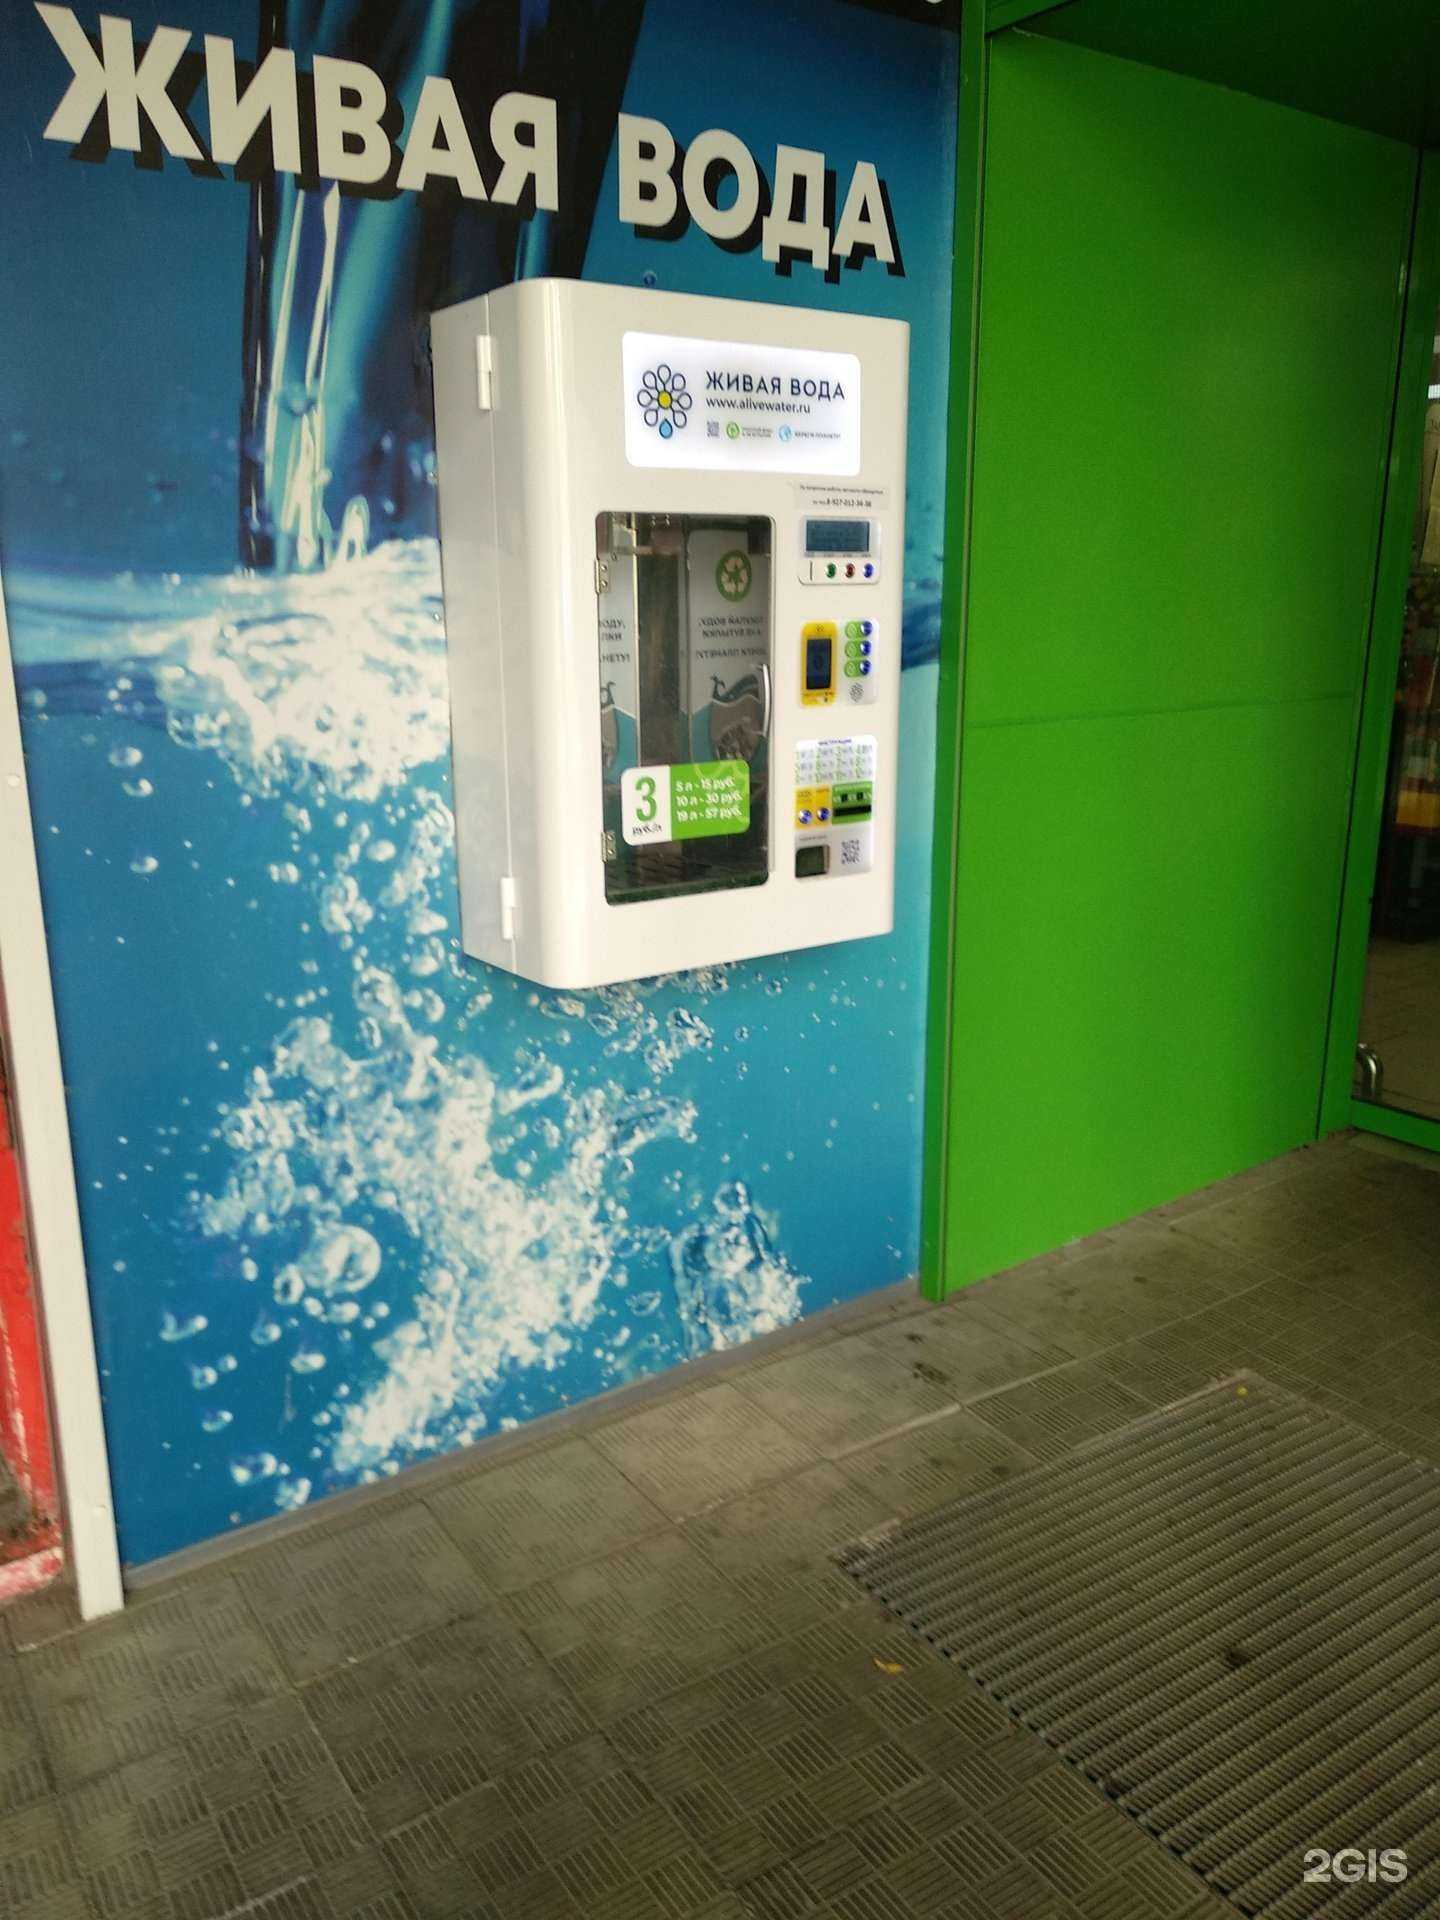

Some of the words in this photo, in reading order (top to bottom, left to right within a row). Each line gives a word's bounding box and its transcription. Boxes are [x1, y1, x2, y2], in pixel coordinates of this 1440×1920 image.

[35, 2, 559, 212] ЖИВАЯ
[618, 112, 895, 269] ВОДА
[705, 371, 781, 395] ЖИВАЯ
[790, 378, 845, 401] ВОДА
[705, 397, 811, 414] www.alivewater.ru
[635, 776, 657, 822] 3
